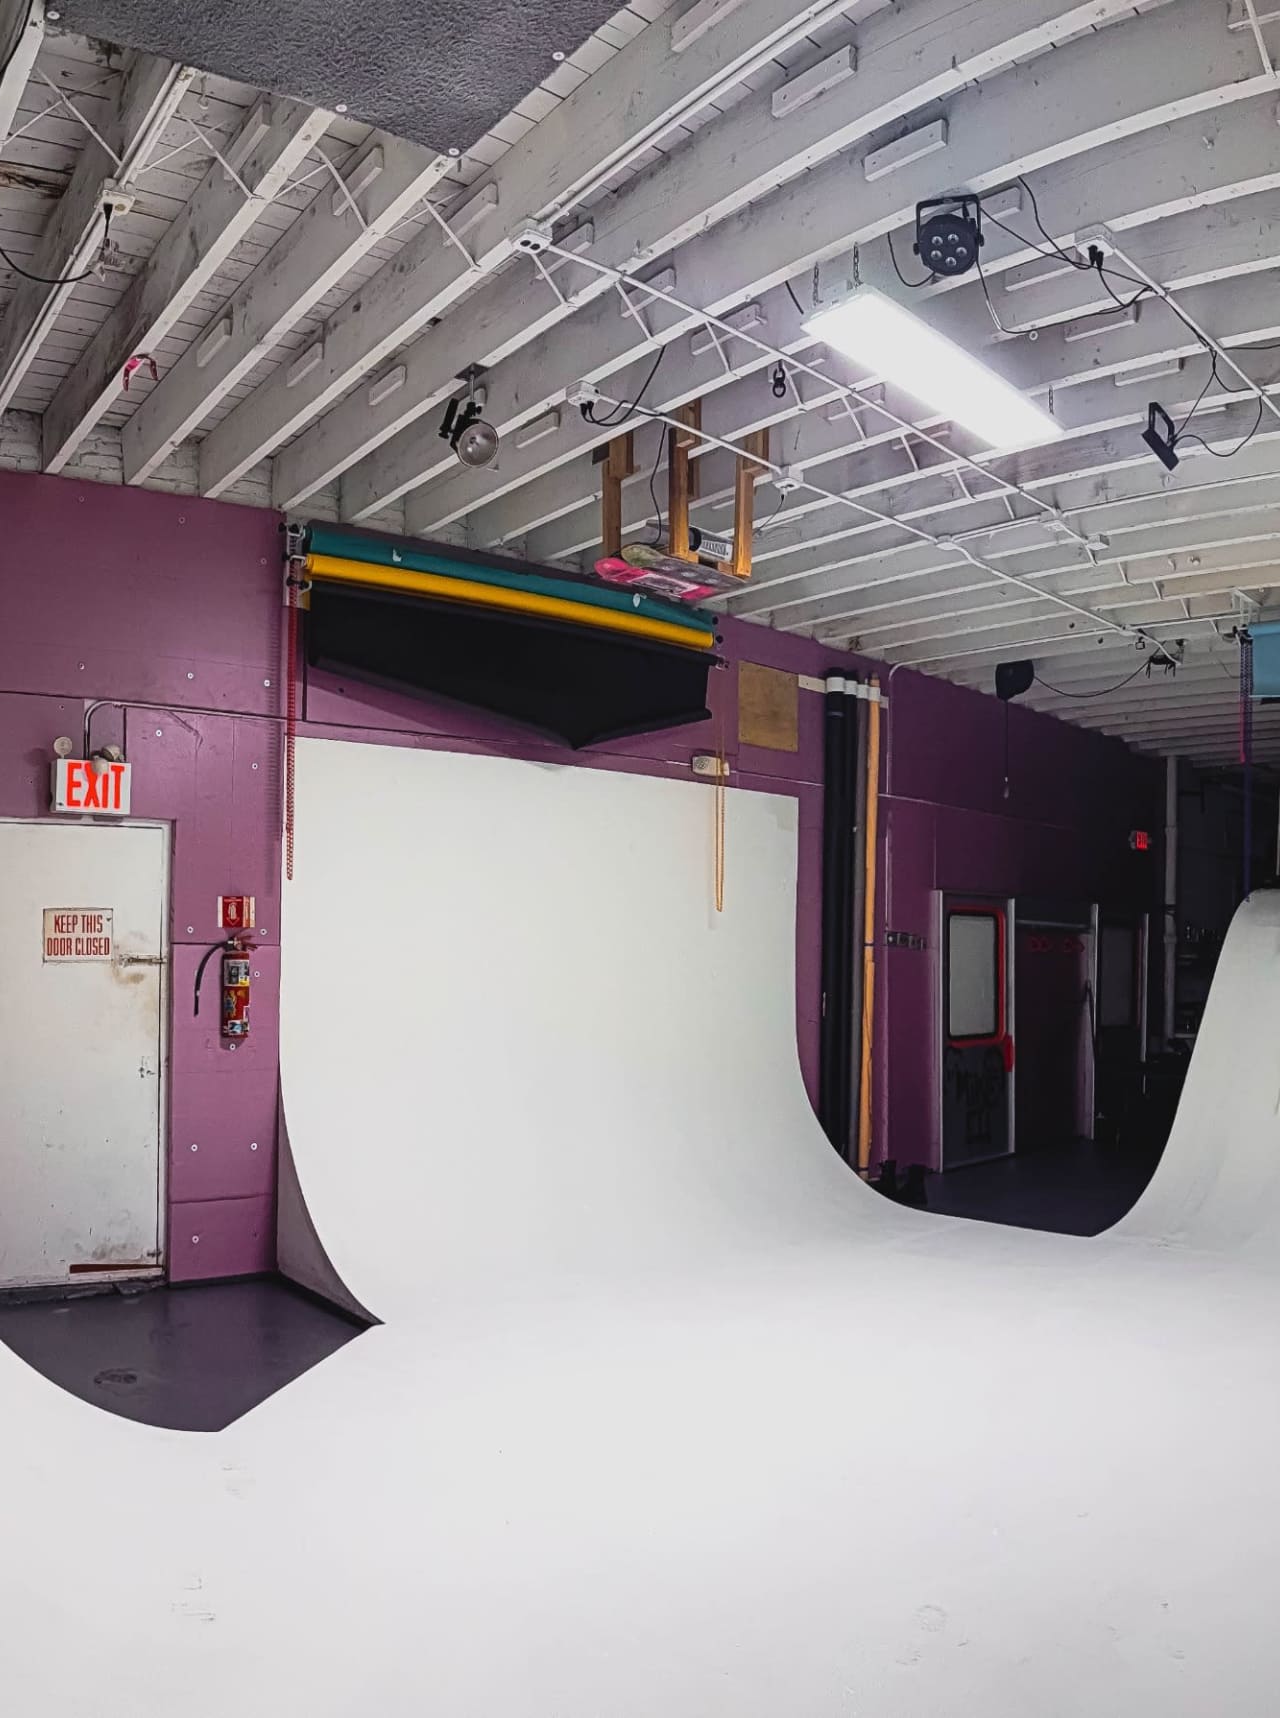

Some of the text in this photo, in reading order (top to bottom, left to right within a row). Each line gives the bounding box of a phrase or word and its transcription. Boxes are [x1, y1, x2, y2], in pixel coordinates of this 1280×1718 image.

[66, 762, 125, 809] EXIT
[54, 914, 103, 934] KEEP THIS
[47, 937, 110, 956] DOOR CLOSED
